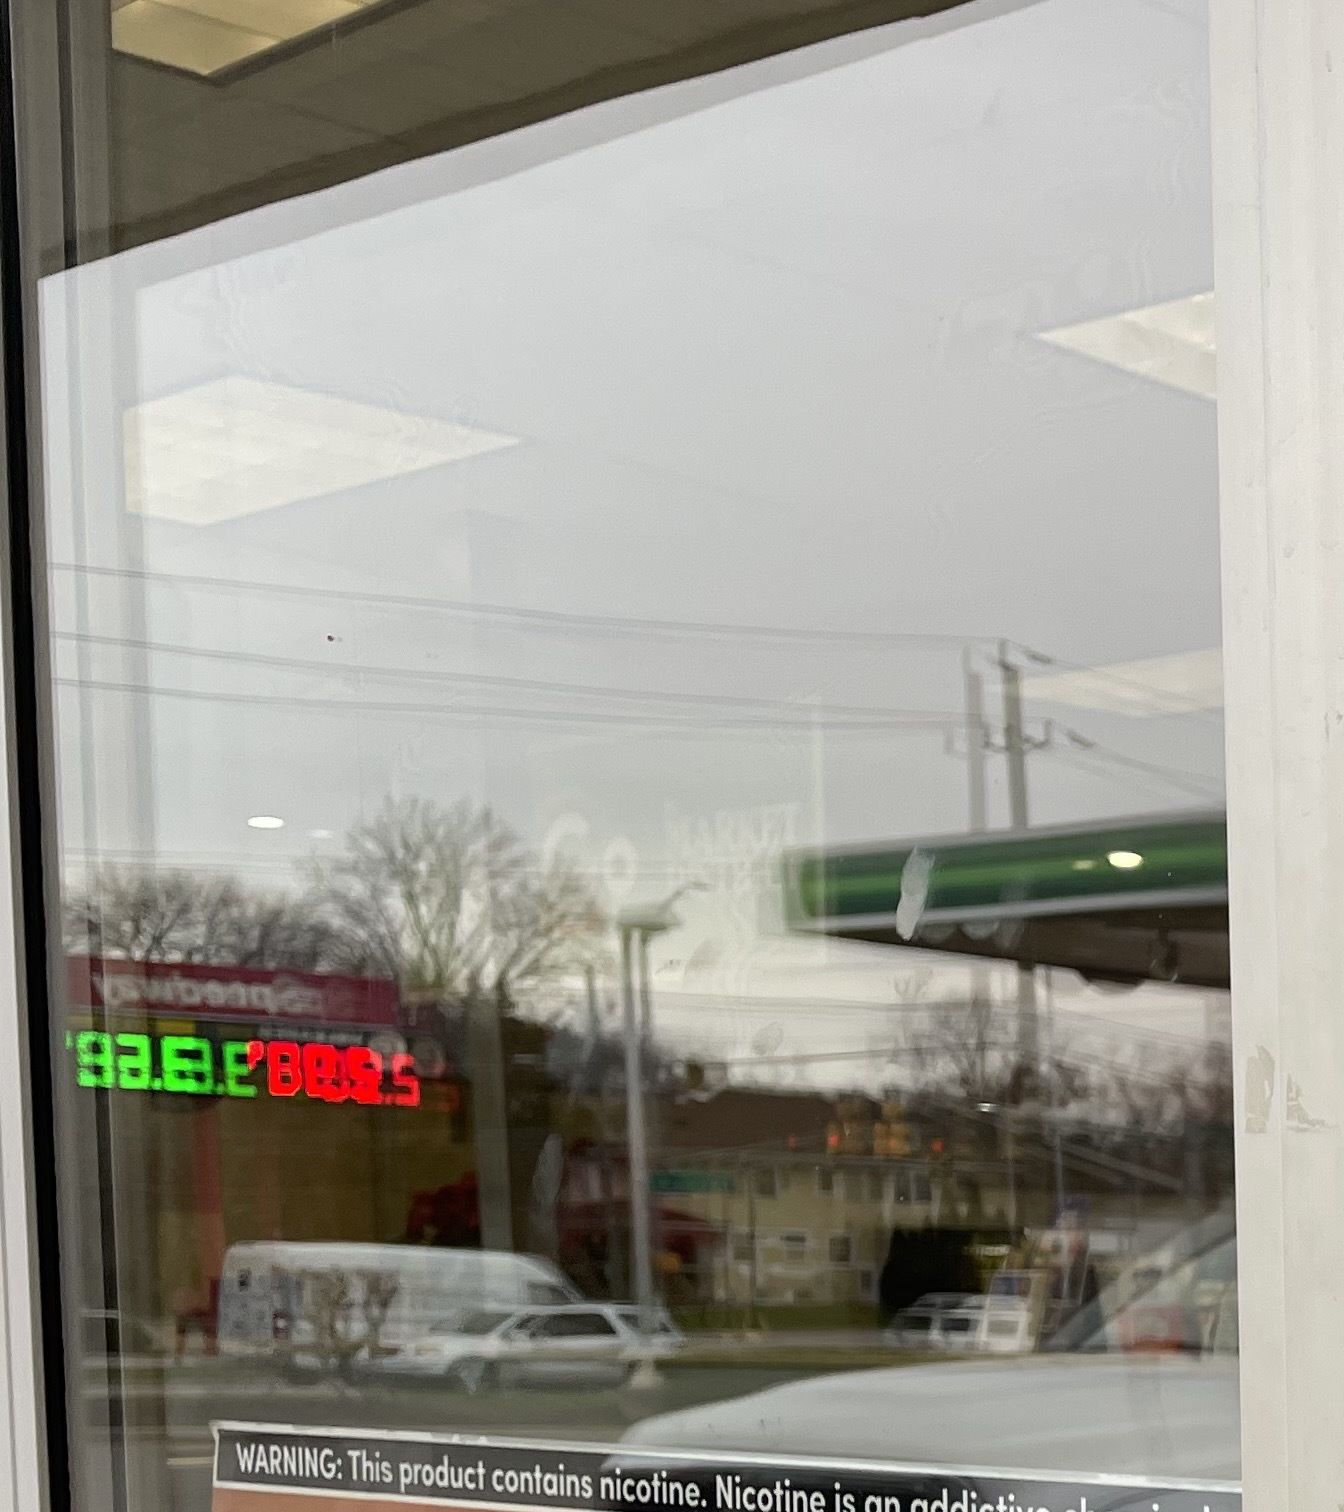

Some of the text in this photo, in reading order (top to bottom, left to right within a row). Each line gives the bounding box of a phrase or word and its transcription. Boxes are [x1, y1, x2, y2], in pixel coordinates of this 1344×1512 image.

[235, 1442, 344, 1481] WARNING:
[348, 1449, 394, 1485] This
[399, 1452, 486, 1493] product
[492, 1462, 592, 1500] contains
[600, 1468, 707, 1508] nicotine.
